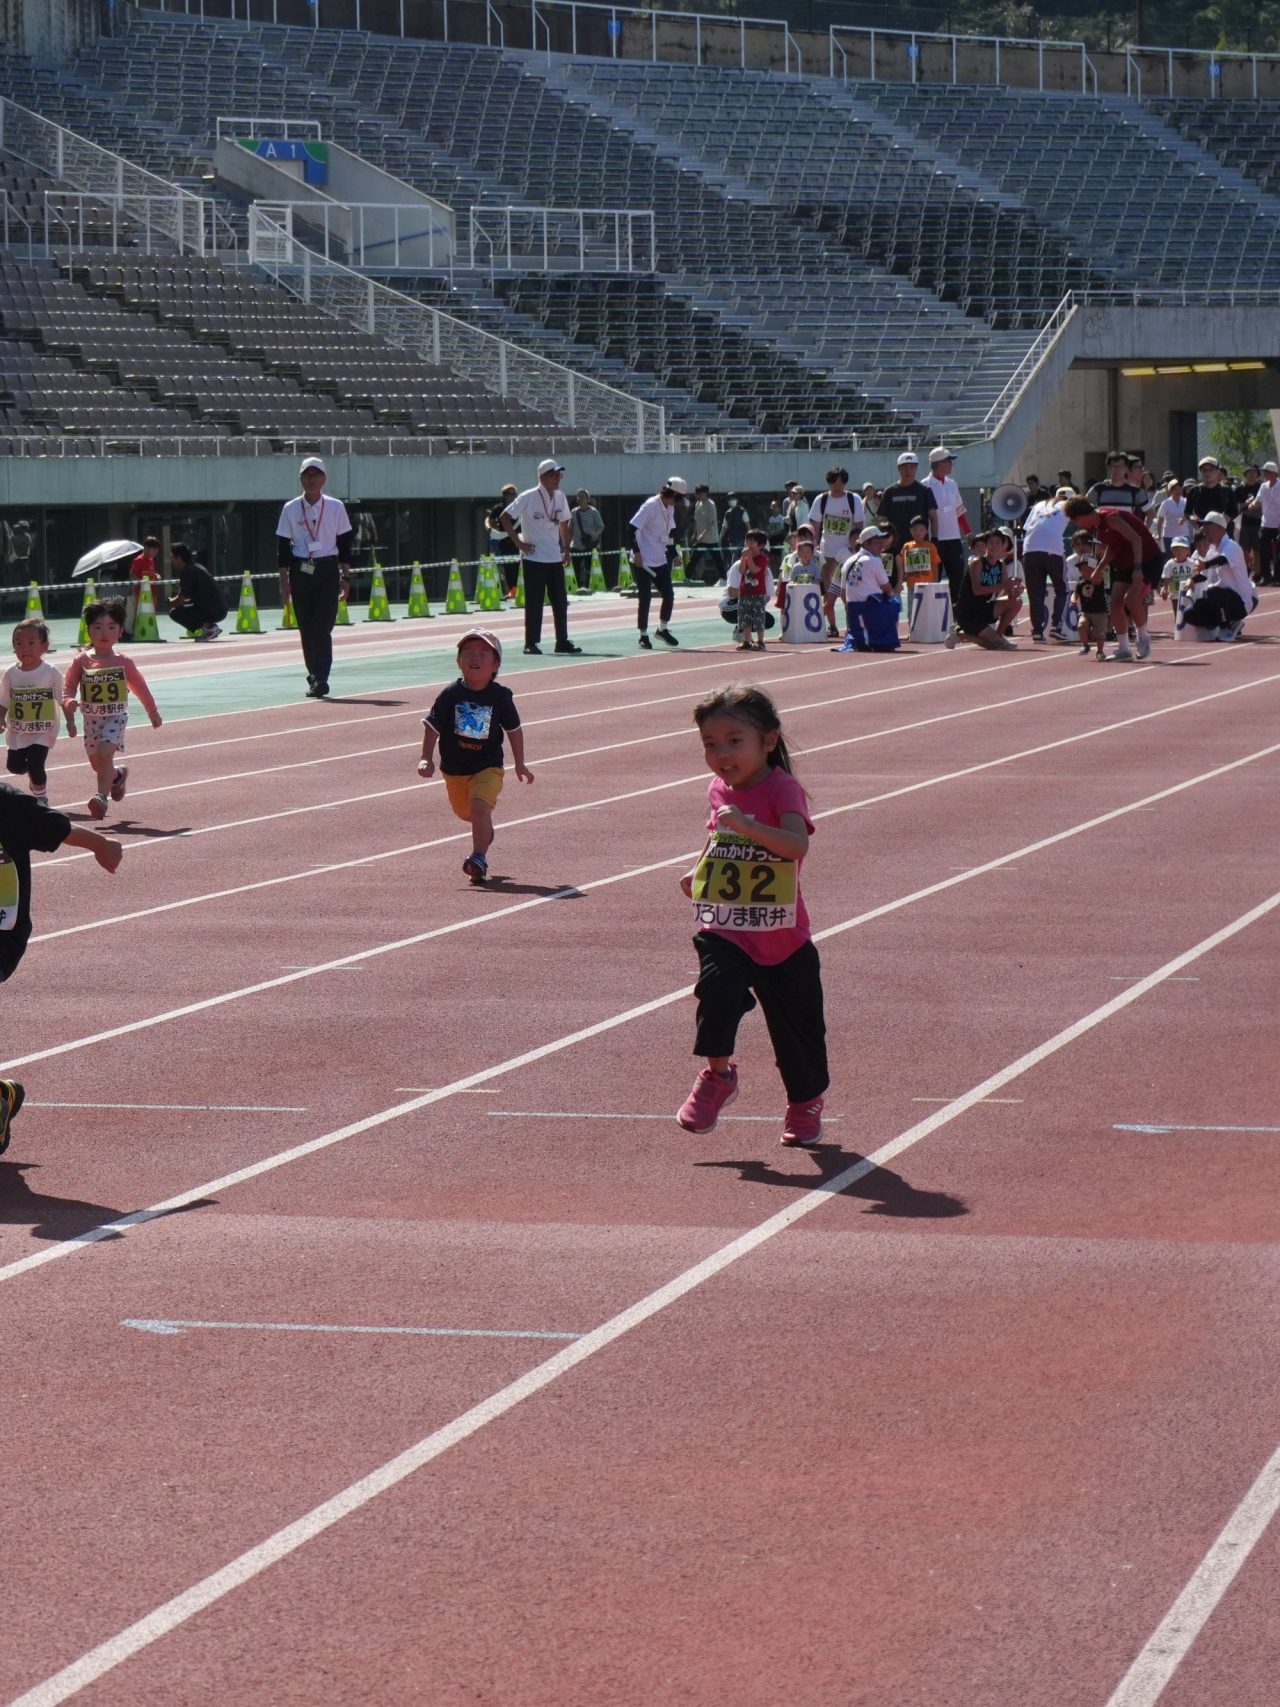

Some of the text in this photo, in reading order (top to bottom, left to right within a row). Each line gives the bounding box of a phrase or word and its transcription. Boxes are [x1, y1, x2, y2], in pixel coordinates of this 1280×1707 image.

[265, 142, 297, 159] A 1
[827, 519, 846, 532] 192
[803, 592, 823, 633] 8
[934, 592, 948, 632] 7
[82, 682, 119, 703] 129
[14, 701, 43, 720] 67
[82, 703, 125, 715] ろしま駅弁
[701, 861, 776, 903] 132
